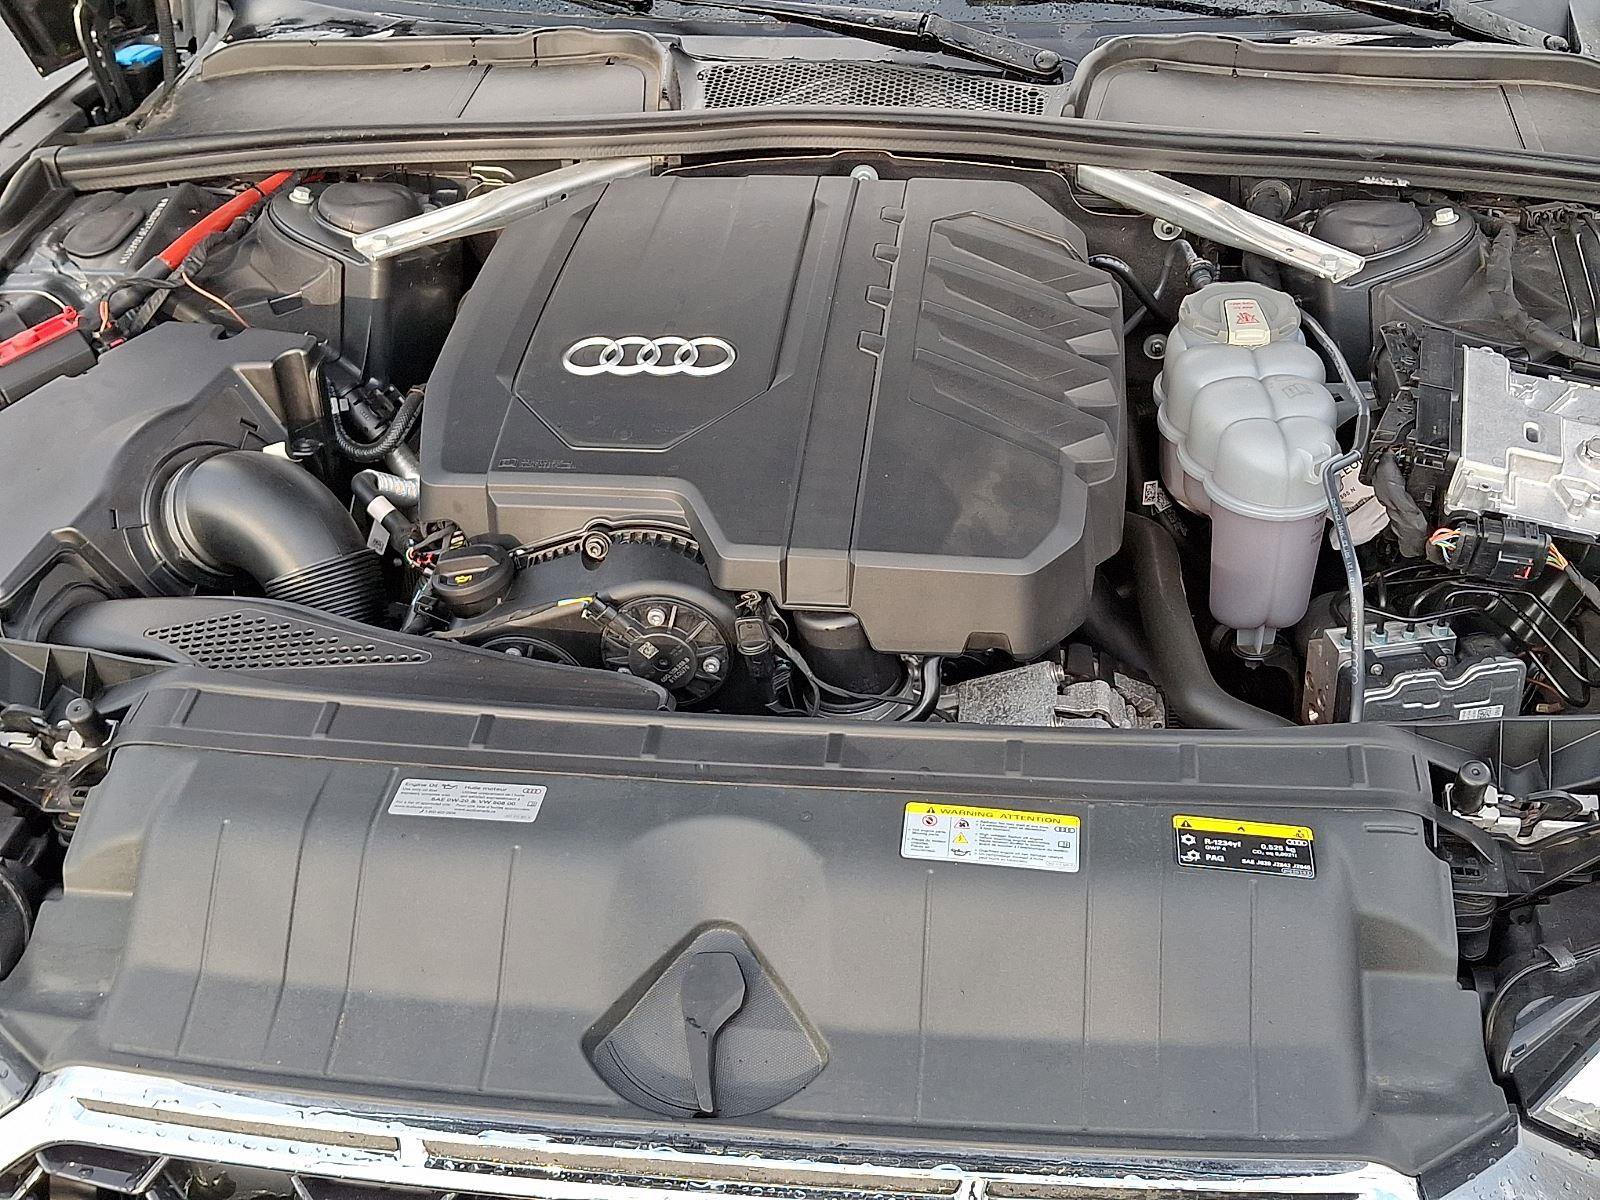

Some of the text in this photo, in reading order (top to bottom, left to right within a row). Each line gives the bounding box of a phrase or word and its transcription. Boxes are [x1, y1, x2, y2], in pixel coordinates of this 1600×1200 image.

[940, 808, 1061, 824] WARNING ATTENTION
[1204, 837, 1242, 848] R-1234yf
[1285, 845, 1297, 853] kg
[1205, 853, 1225, 862] PAG
